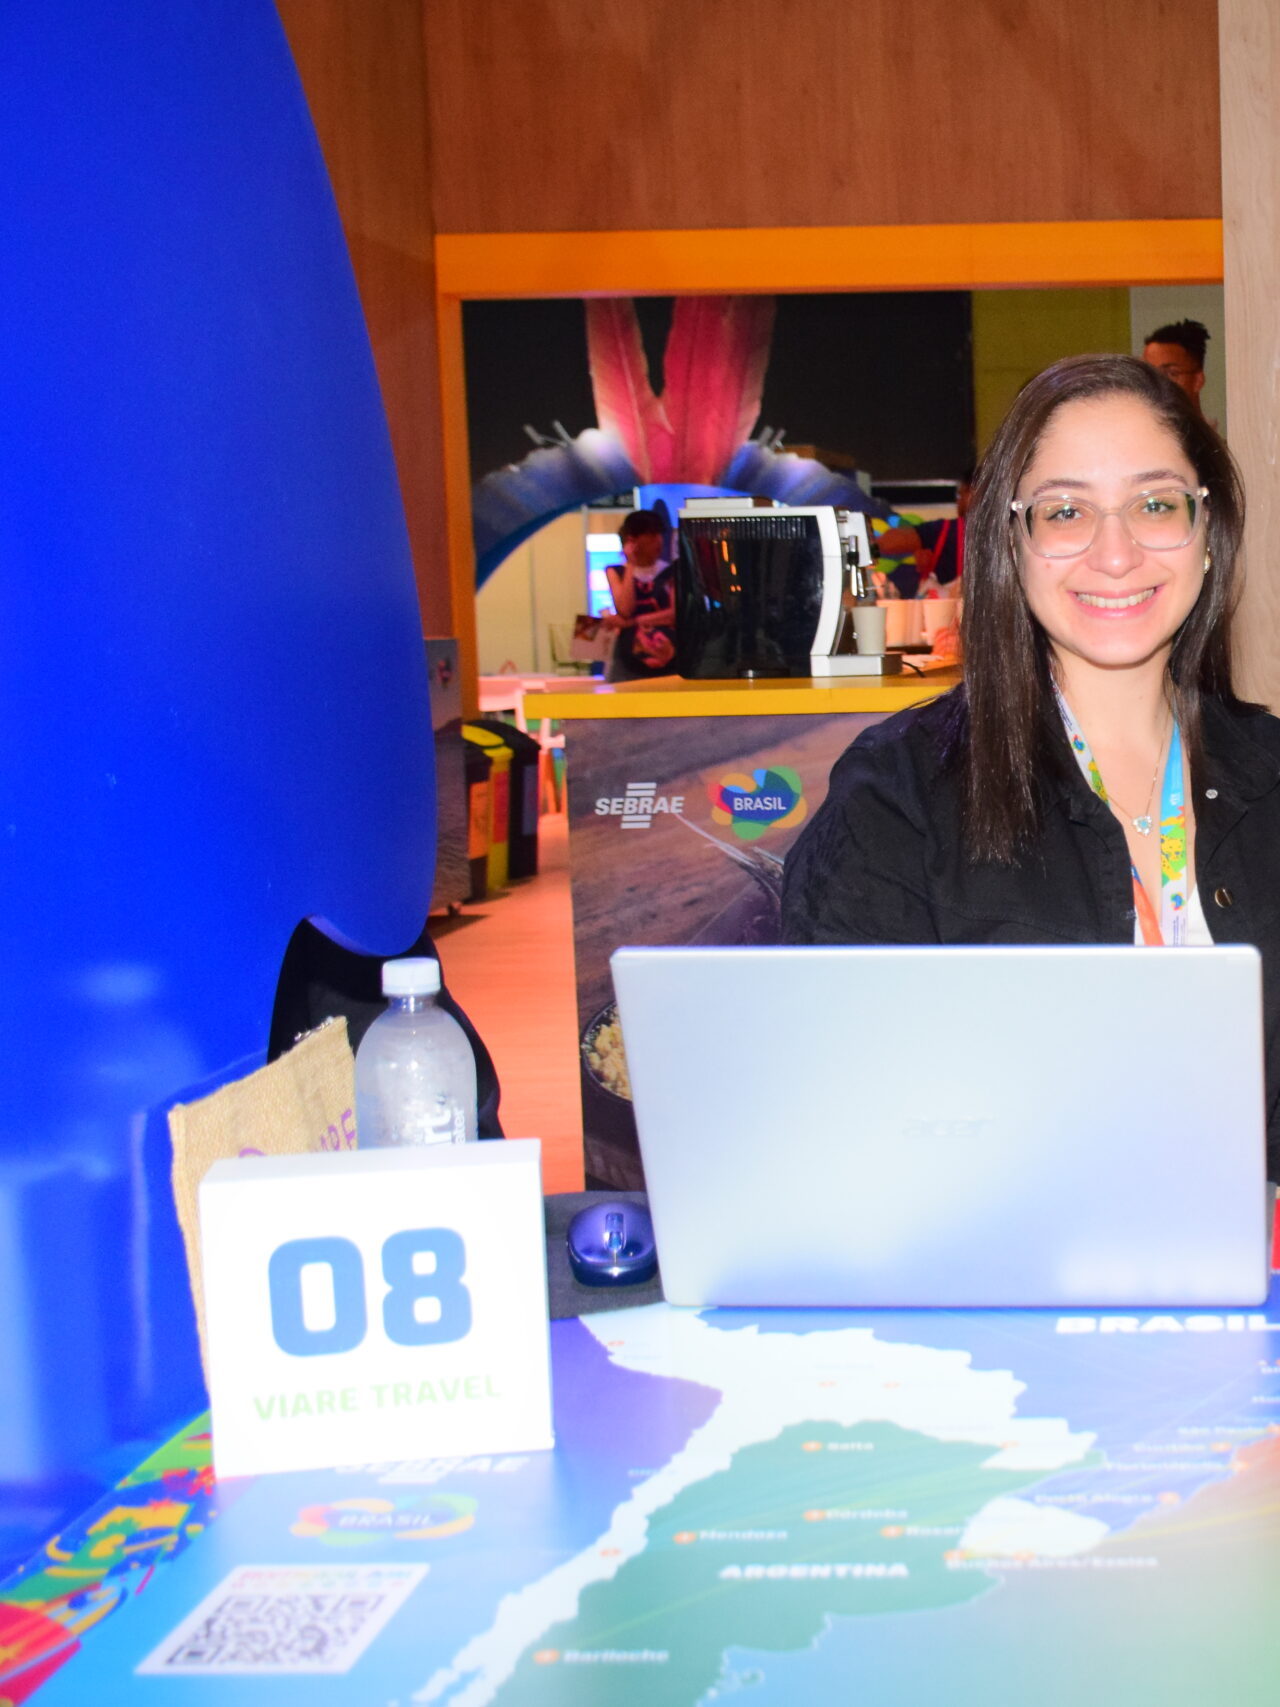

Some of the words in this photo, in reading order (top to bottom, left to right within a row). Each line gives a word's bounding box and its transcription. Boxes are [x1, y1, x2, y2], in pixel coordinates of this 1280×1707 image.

[594, 796, 685, 816] SEBRAE
[733, 797, 787, 812] BRASIL
[268, 1226, 473, 1358] 08
[253, 1387, 361, 1422] VIARE
[369, 1374, 504, 1409] TRAVEL
[338, 1512, 434, 1528] BRASIL
[699, 1529, 788, 1541] Mendoza
[718, 1562, 909, 1579] ARGENTINA
